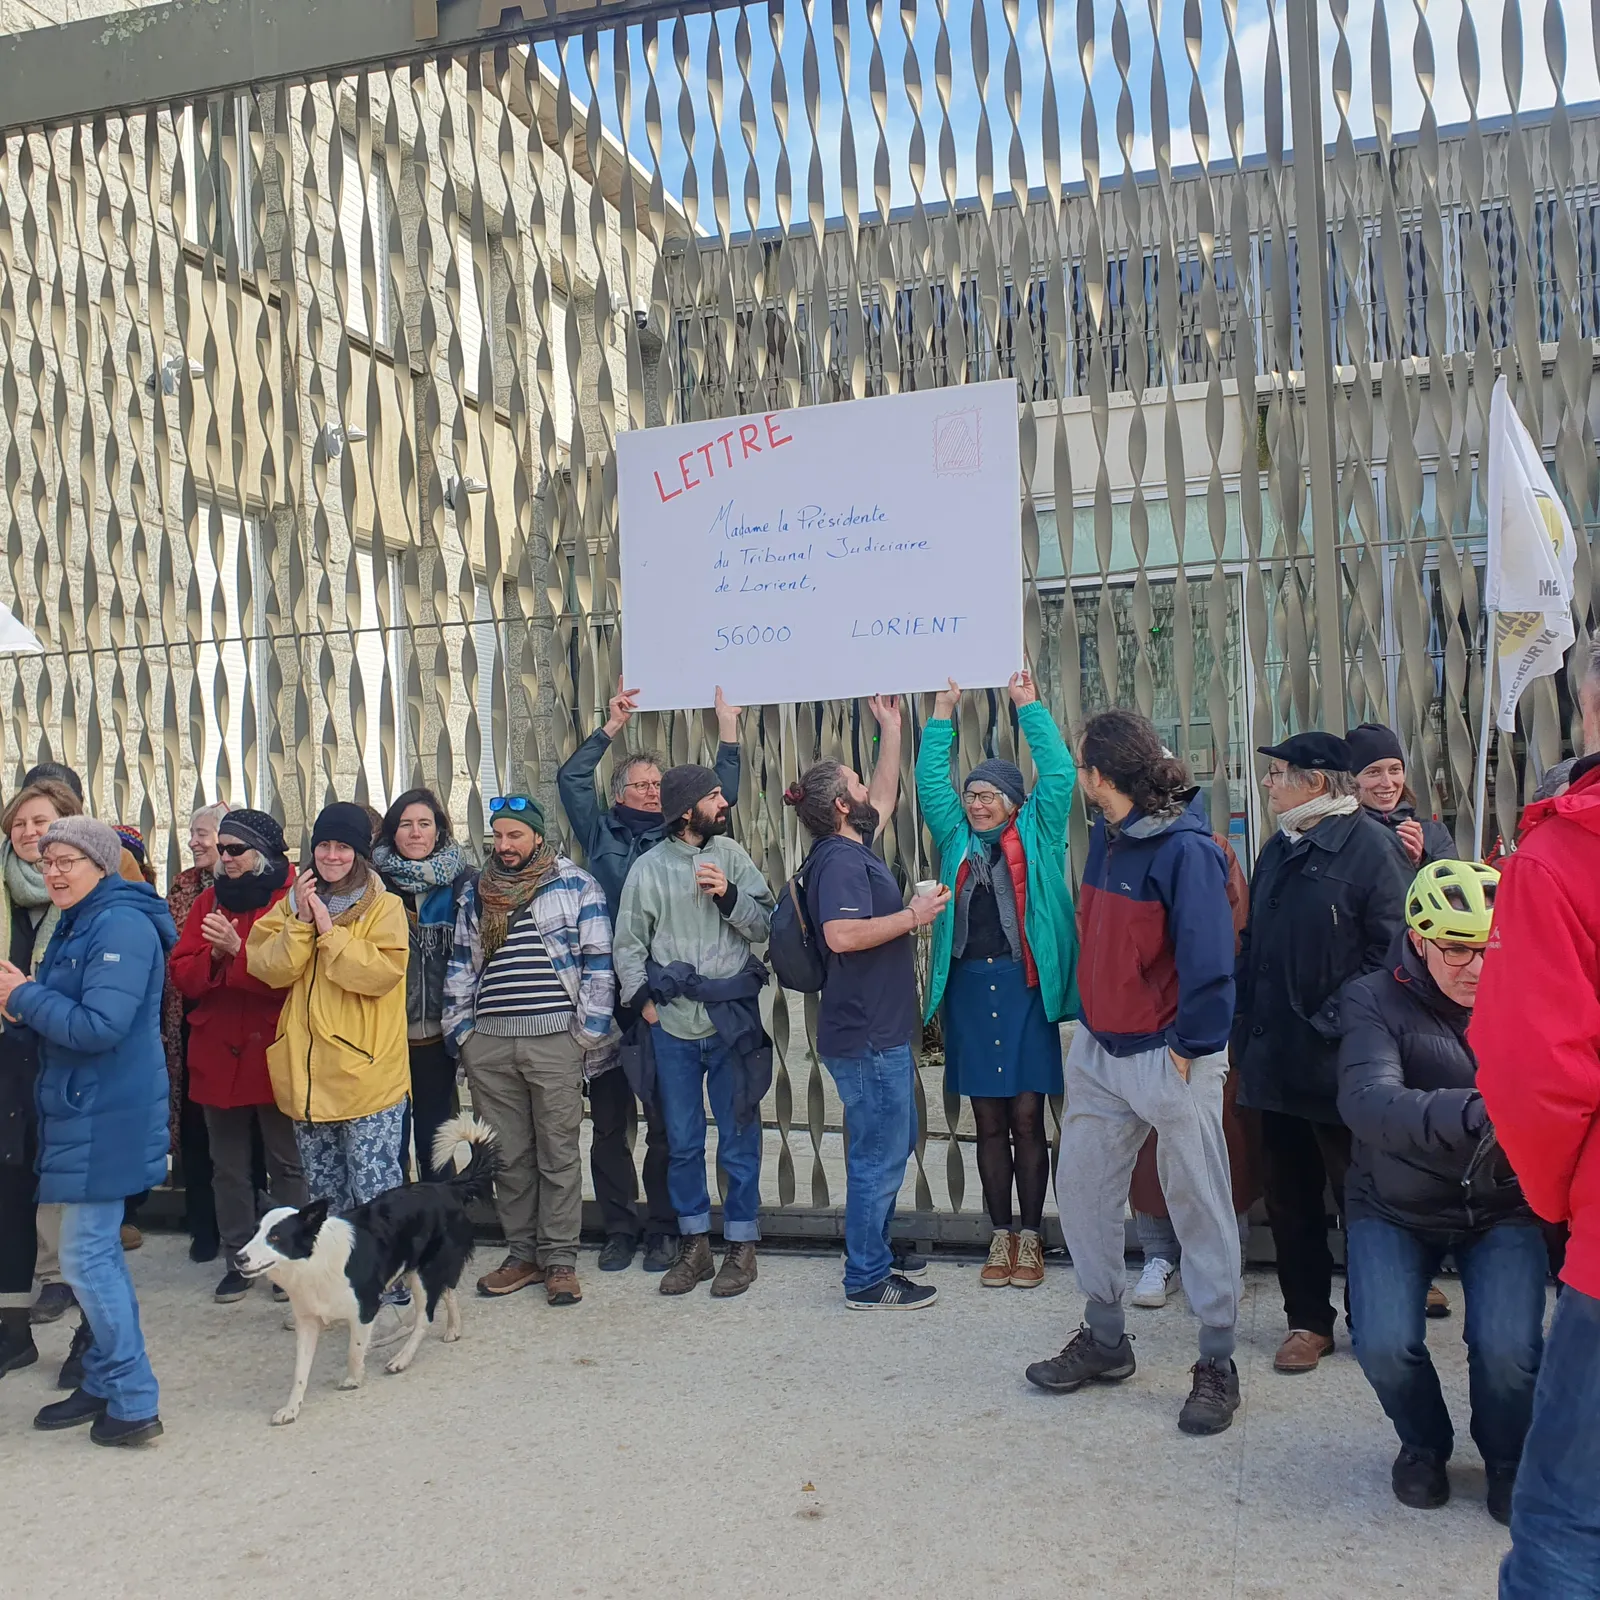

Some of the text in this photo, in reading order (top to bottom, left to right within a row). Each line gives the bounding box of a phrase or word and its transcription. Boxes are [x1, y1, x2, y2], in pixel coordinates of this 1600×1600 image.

[653, 413, 793, 503] LETTRE
[709, 499, 889, 540] Madame la Présidente
[713, 536, 931, 569] du Tribunal Judiciaire
[714, 573, 817, 593] de Lorient,
[714, 625, 792, 651] 56000
[1503, 645, 1545, 717] FAUCHEUR
